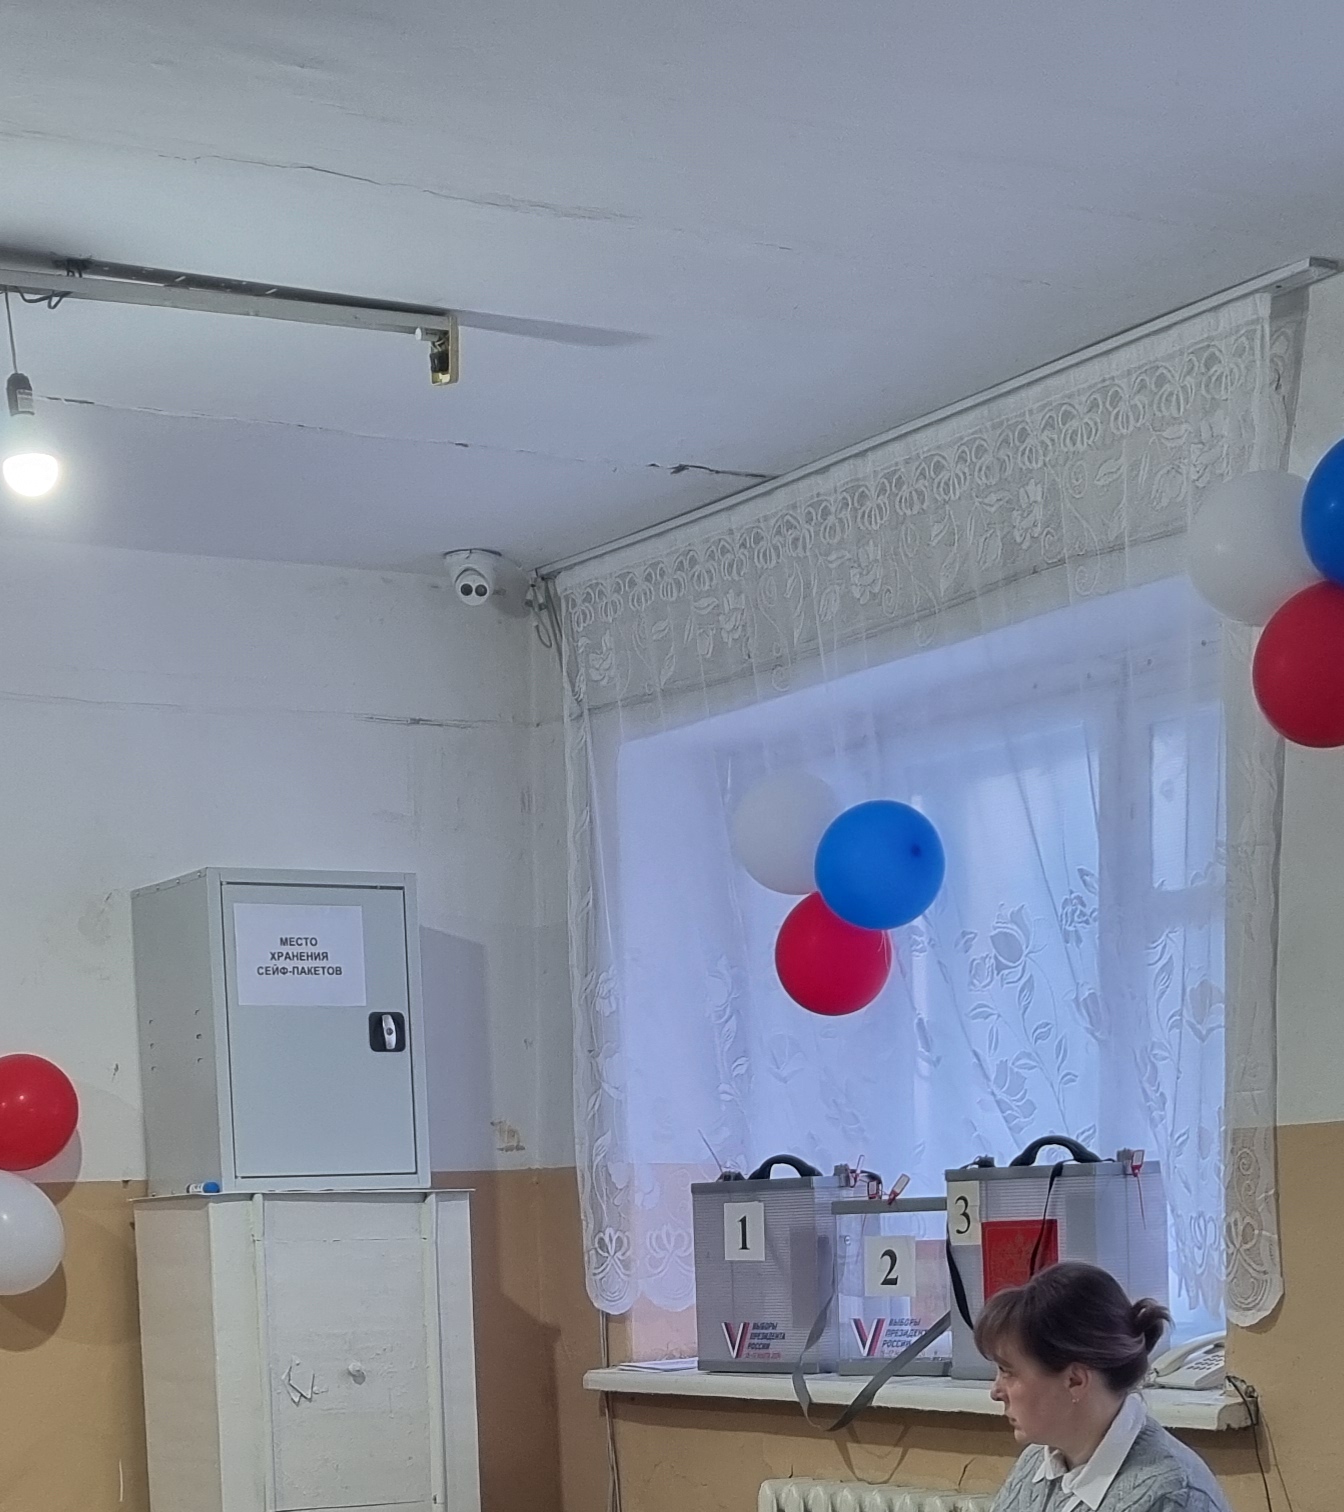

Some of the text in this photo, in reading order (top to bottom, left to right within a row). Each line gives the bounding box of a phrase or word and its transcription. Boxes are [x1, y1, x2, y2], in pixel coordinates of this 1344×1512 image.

[279, 937, 318, 947] МЕСТО
[269, 951, 329, 962] ХРАНЕНИЯ
[256, 964, 343, 976] СЕЙФ-ПАКЕТОВ
[954, 1195, 971, 1235] 3
[737, 1215, 751, 1251] 1
[880, 1249, 899, 1286] 2
[888, 1317, 921, 1326] ВЫБОРЫ
[885, 1328, 928, 1338] ПРЕЗИДЕН
